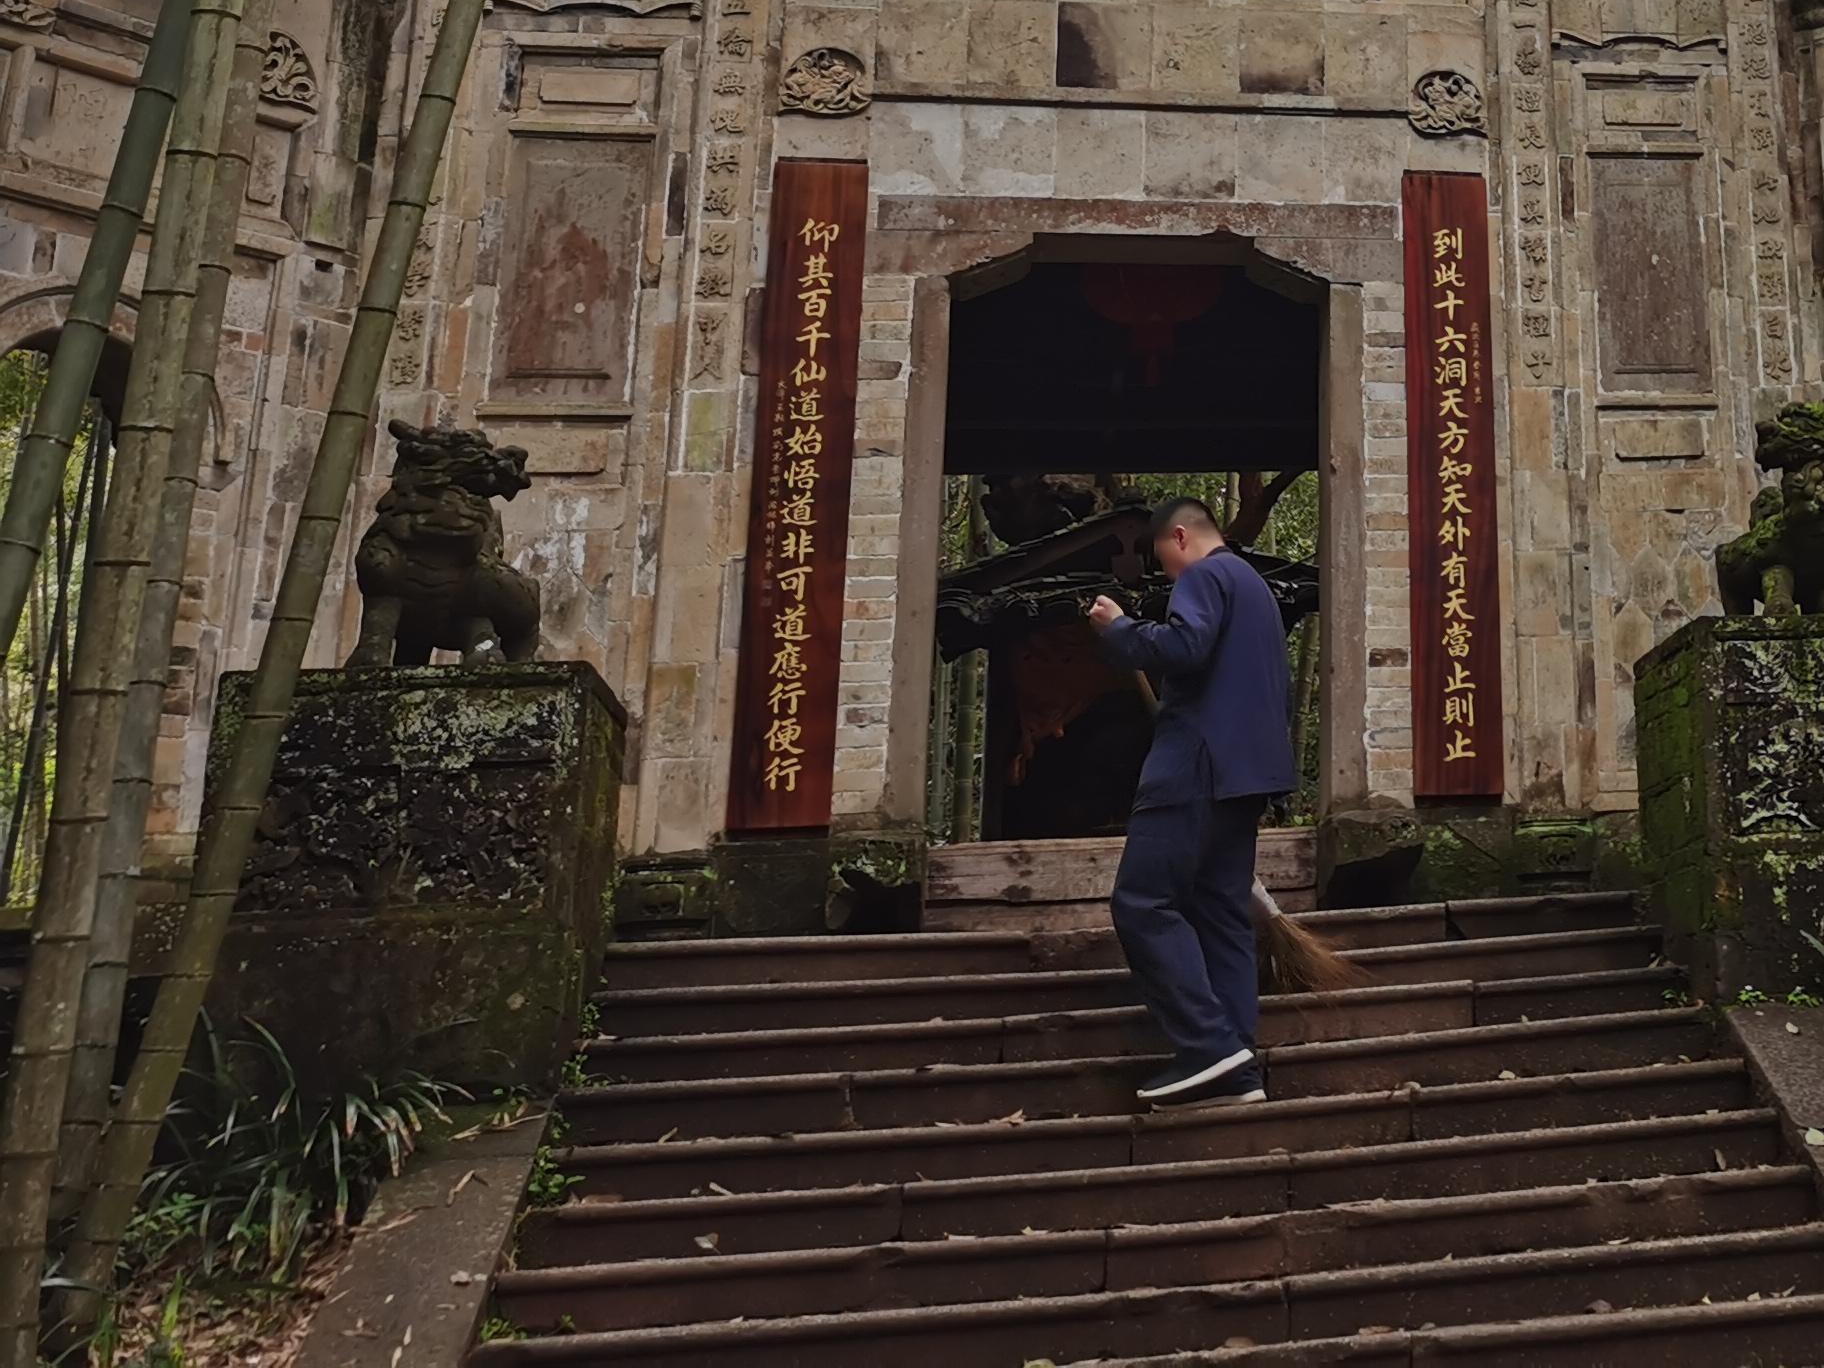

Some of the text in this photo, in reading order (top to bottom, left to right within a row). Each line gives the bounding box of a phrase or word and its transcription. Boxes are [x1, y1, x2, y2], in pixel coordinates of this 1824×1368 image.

[1431, 227, 1477, 763] 到此十六洞天方知天外有天當止則止
